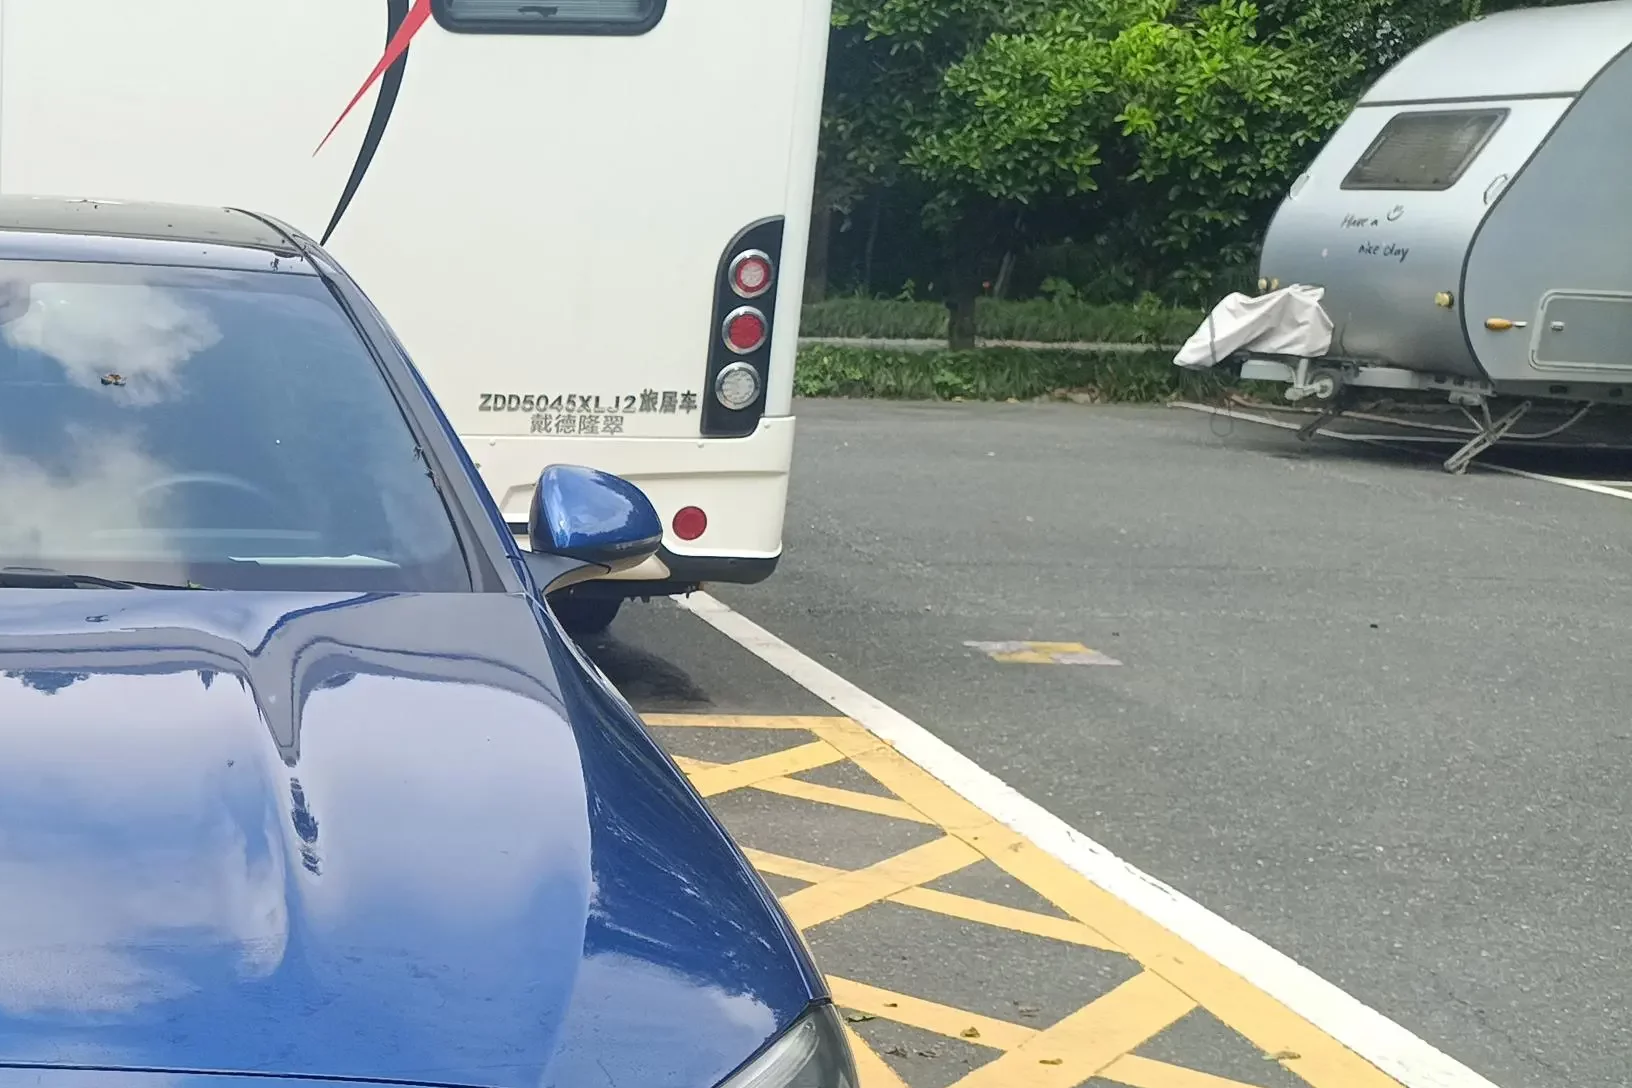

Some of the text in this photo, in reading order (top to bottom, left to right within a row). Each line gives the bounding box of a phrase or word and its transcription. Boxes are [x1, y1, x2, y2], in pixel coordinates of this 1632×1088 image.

[1383, 243, 1410, 263] day
[530, 414, 625, 435] 戴德隆翠
